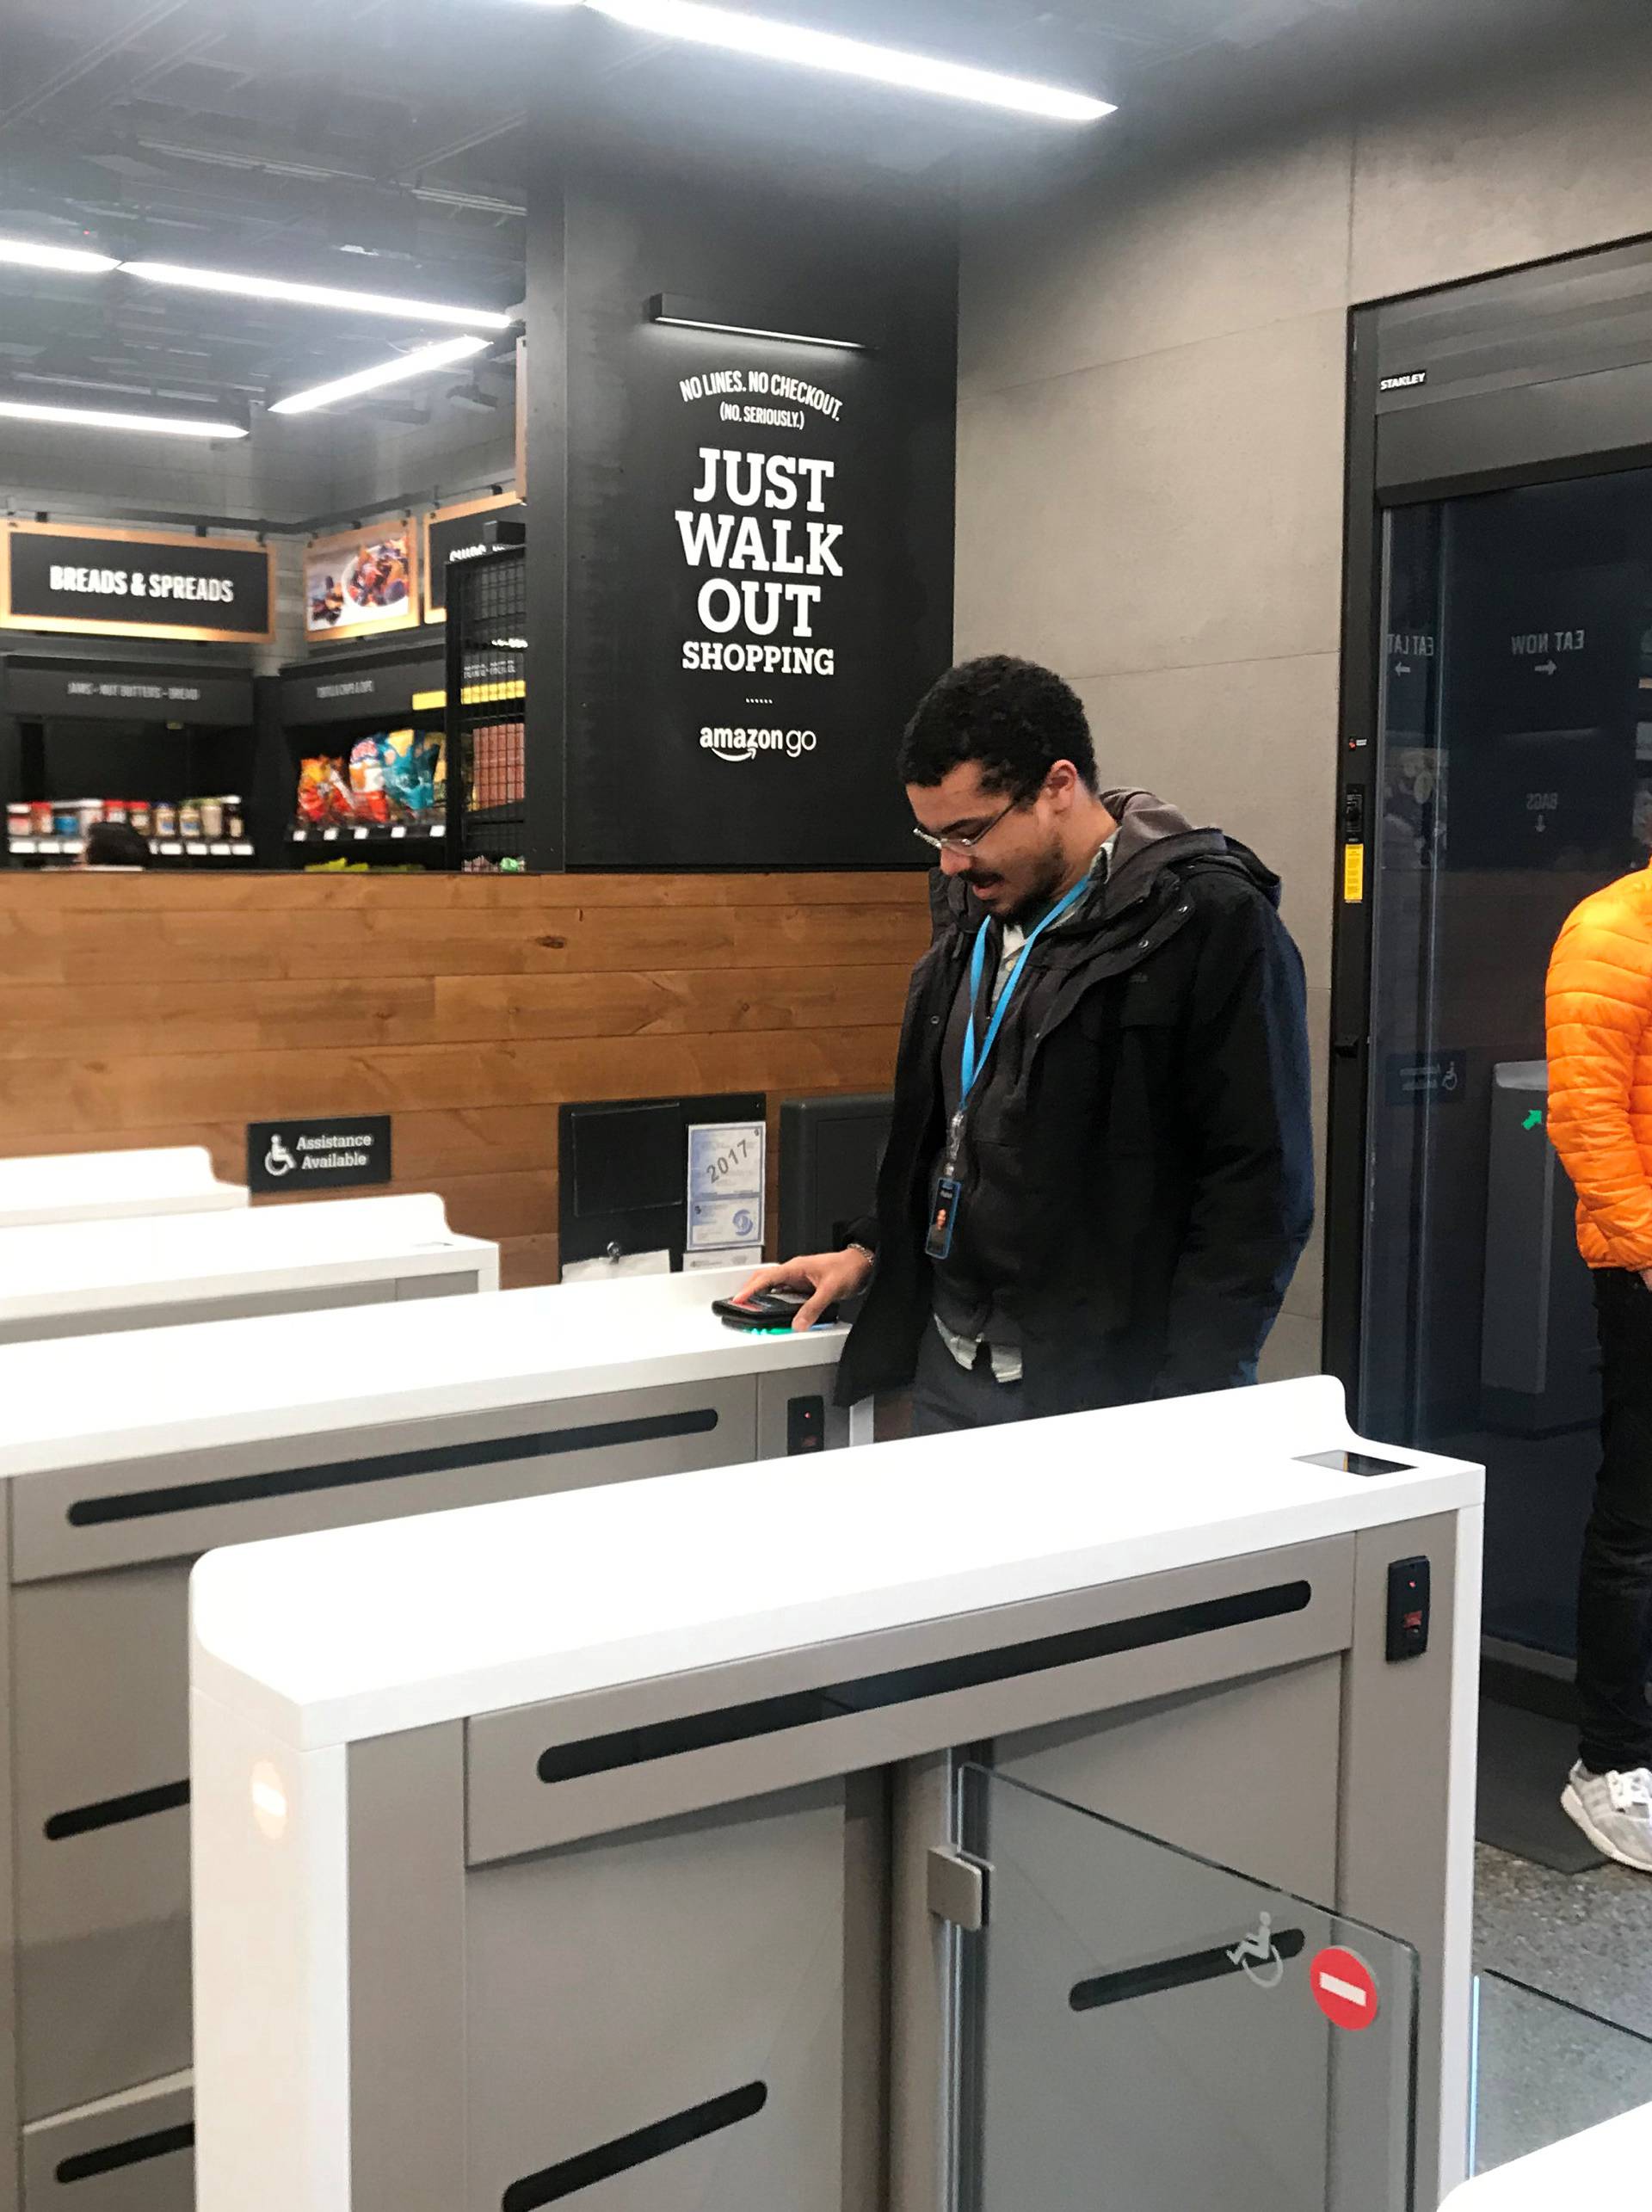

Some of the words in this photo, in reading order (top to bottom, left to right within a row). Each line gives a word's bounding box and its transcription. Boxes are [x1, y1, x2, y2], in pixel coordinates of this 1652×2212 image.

[679, 376, 703, 403] NO
[702, 370, 747, 396] LINES.
[749, 371, 769, 394] NO
[771, 373, 843, 422] CHECKOUT.
[743, 405, 805, 430] SERIOUSLY.)
[693, 447, 835, 513] JUST
[675, 509, 843, 577] WALK
[49, 564, 128, 595] BREADS
[130, 572, 146, 596] &
[149, 573, 234, 603] SPREADS
[697, 577, 821, 638] OUT
[682, 640, 835, 675] SHOPPING
[700, 726, 783, 755] amazon
[786, 729, 817, 758] go
[296, 1134, 373, 1151] Assistance
[301, 1152, 367, 1170] Available
[706, 1138, 749, 1185] 2017
